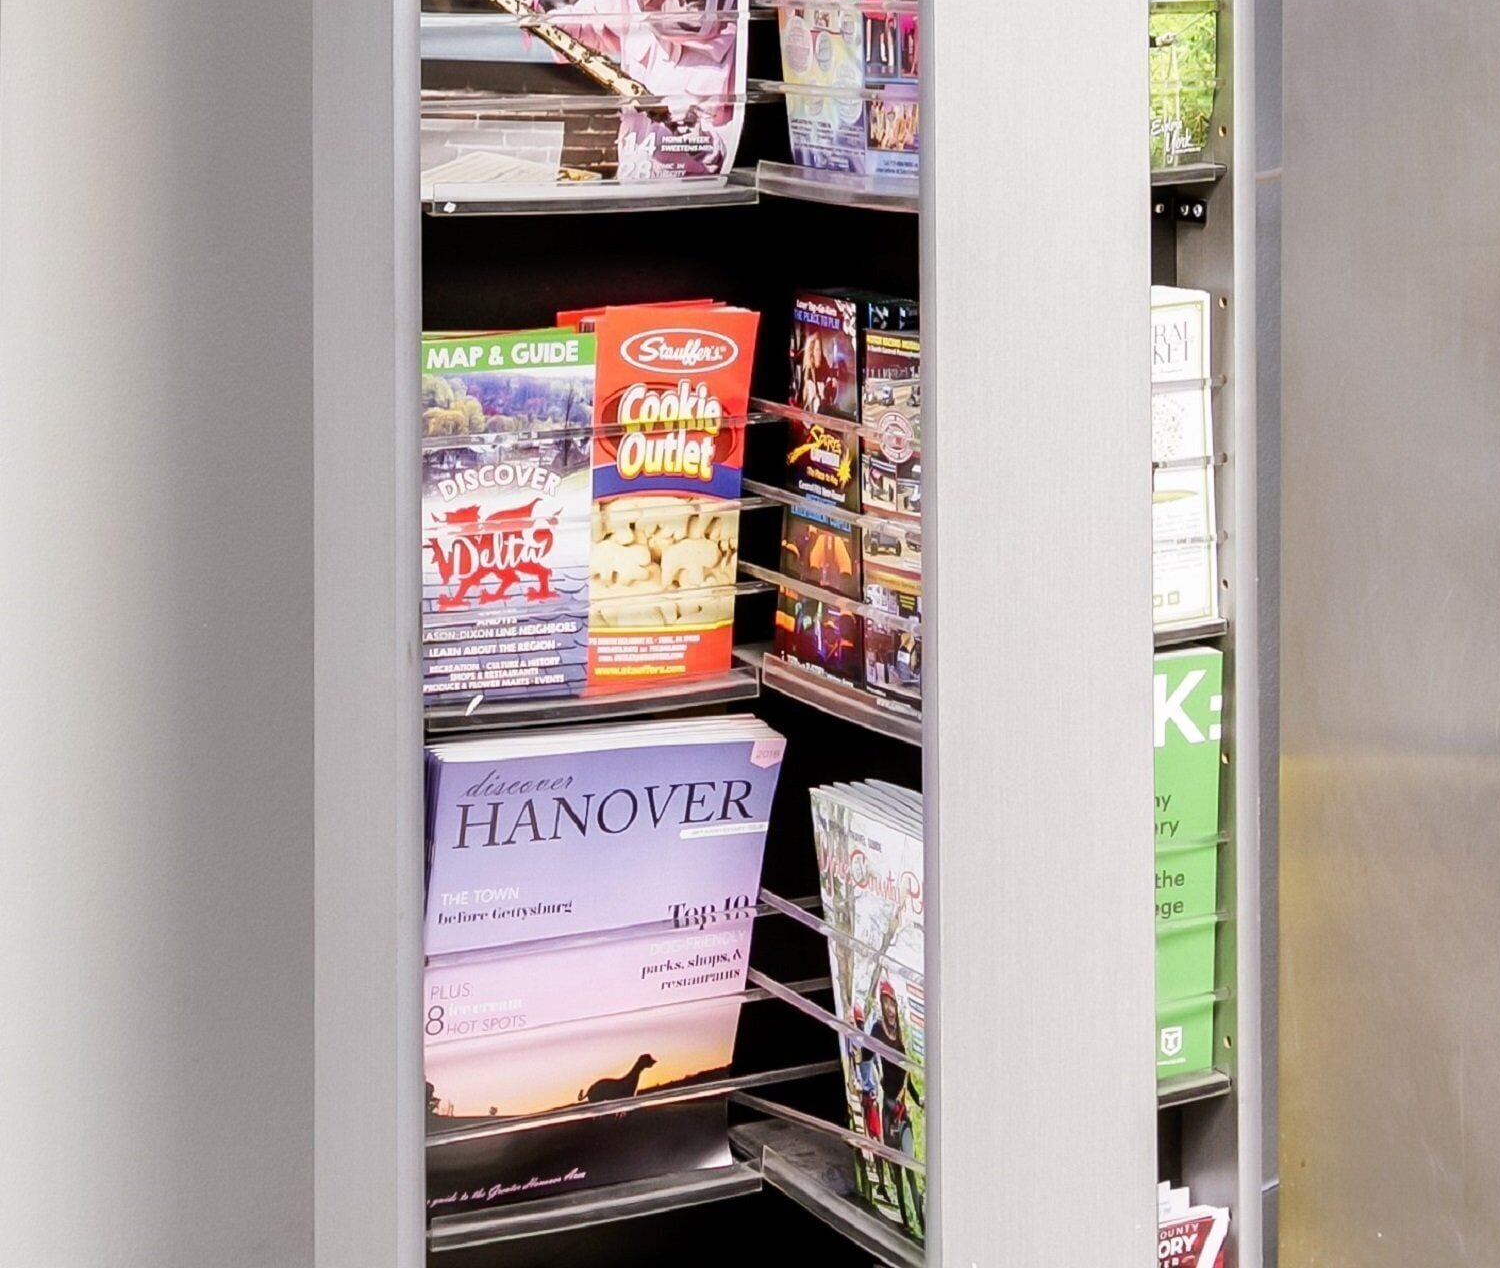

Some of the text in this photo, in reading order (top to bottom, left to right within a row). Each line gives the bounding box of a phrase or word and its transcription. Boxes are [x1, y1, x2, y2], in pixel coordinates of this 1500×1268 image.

[624, 132, 656, 156] 14
[427, 340, 580, 370] MAP & GUIDE
[638, 336, 723, 366] Stauffer's
[617, 378, 722, 435] Cookie
[616, 431, 715, 481] Outlet
[437, 465, 562, 502] DISCOVER
[450, 530, 553, 579] Delta
[495, 626, 517, 638] LINE
[519, 622, 577, 634] NEIGHBORS
[429, 640, 555, 657] LEARN ABOUT THE REGION
[534, 674, 564, 684] EVENTS
[463, 769, 574, 799] discover
[452, 779, 754, 849] HANOVER
[1155, 820, 1180, 838] ry
[441, 887, 519, 906] THE TOWN
[438, 900, 572, 925] before Gettysburg
[641, 959, 685, 979] parks,
[687, 951, 731, 968] shops,
[661, 968, 741, 990] restaurants
[425, 1005, 445, 1036] 8
[446, 1014, 528, 1036] HOT SPOTS
[1160, 1222, 1199, 1240] OUNTY
